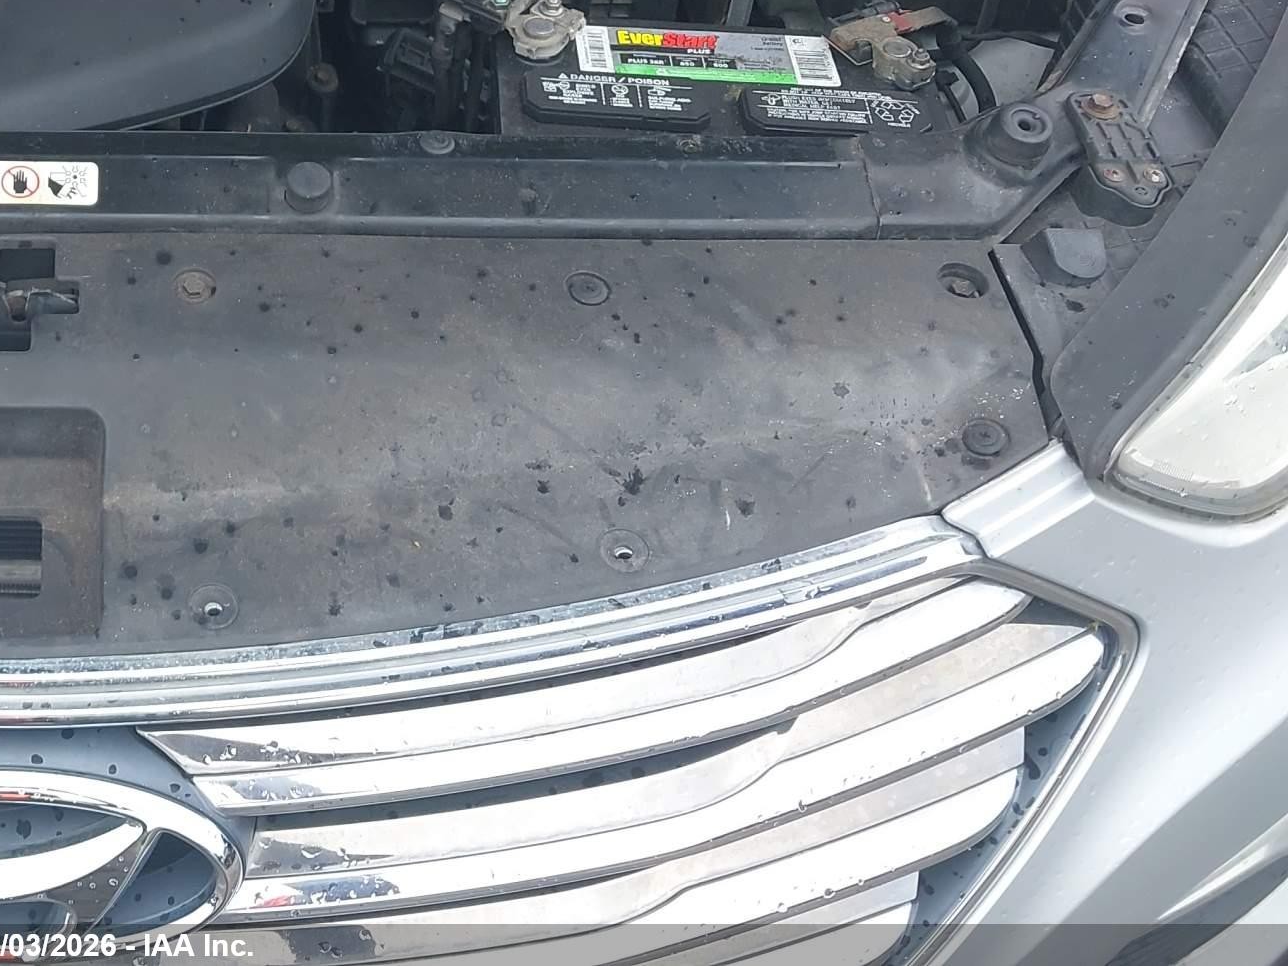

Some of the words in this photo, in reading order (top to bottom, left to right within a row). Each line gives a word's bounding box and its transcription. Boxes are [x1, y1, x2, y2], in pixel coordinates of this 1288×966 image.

[617, 30, 717, 49] EverStart
[570, 74, 616, 83] DANGER
[628, 77, 670, 86] POISON
